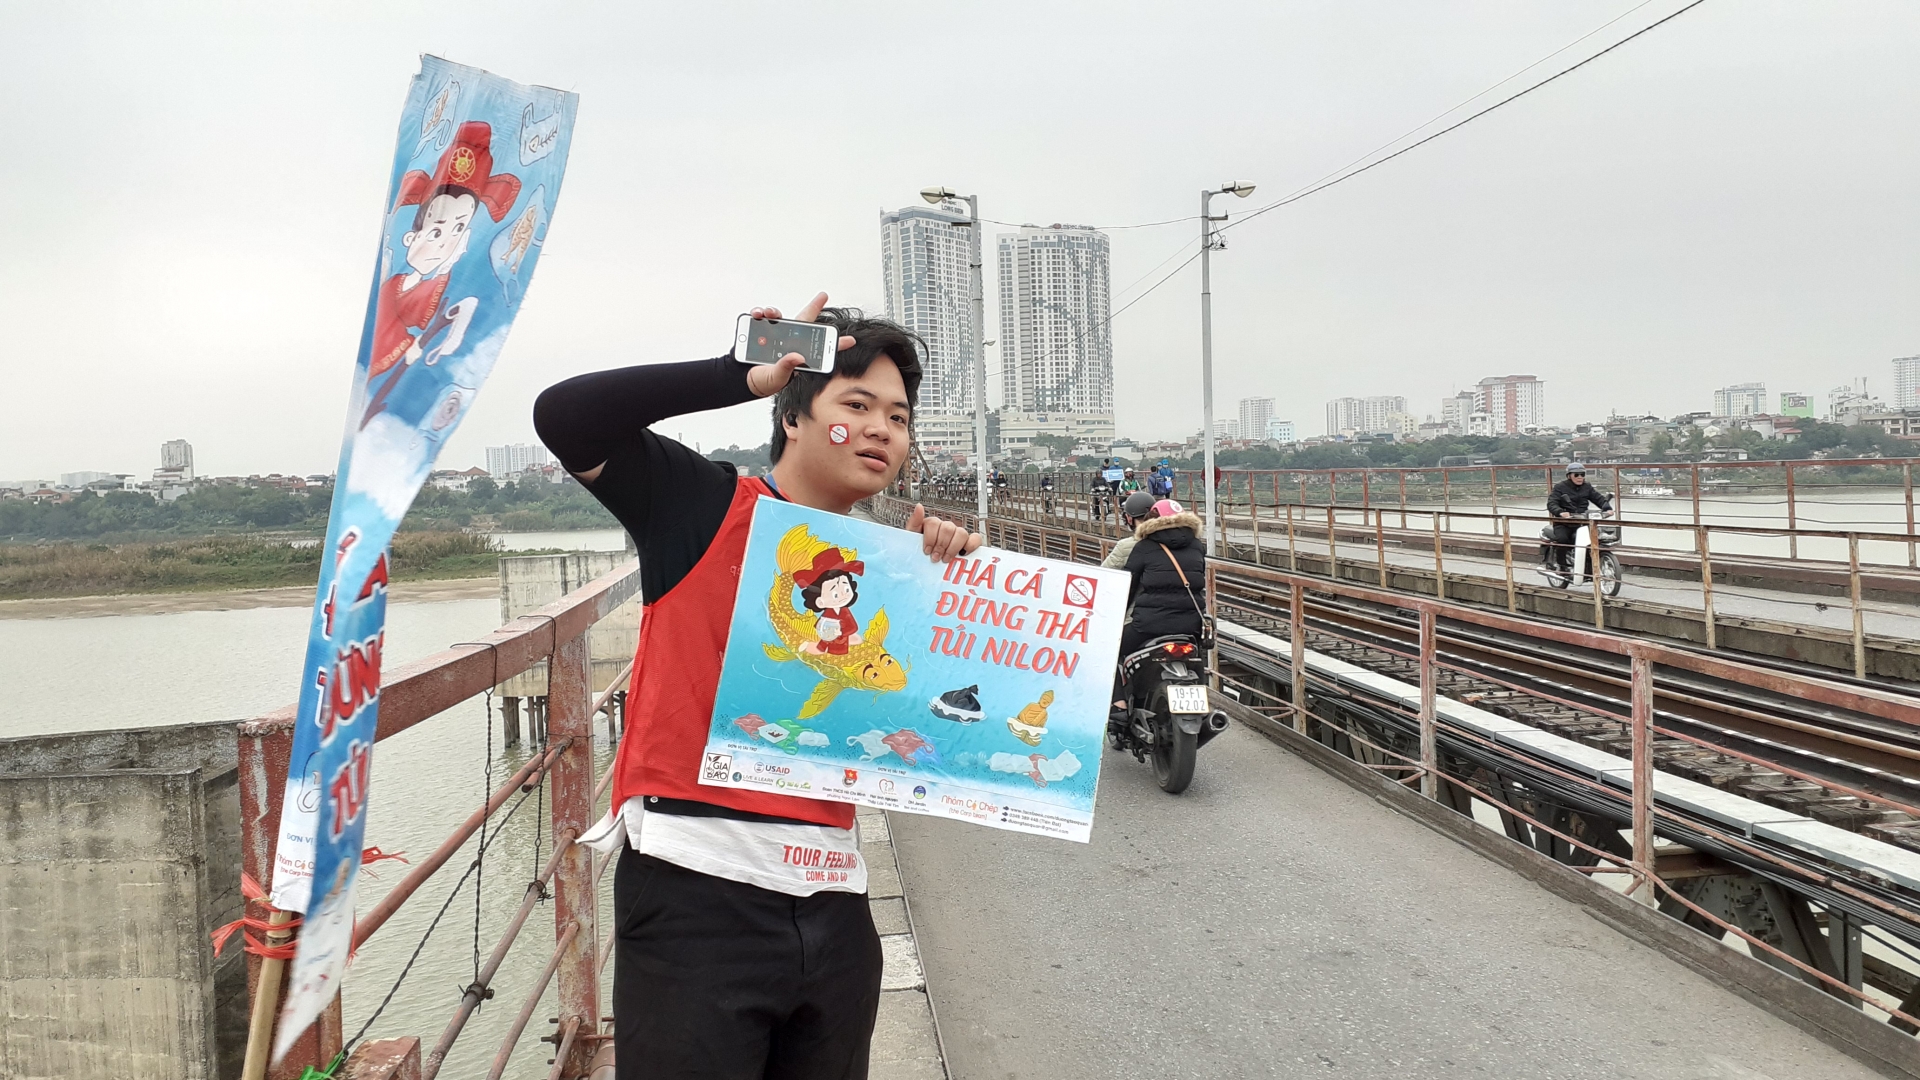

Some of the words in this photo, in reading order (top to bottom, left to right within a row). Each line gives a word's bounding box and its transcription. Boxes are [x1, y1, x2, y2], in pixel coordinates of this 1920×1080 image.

[943, 556, 1001, 590] THẢ
[1004, 567, 1048, 598] CÁ
[934, 589, 1029, 631] ĐỪNG
[1035, 610, 1094, 643] THẢ
[929, 624, 977, 659] TÚI
[981, 636, 1080, 678] NILON
[1175, 688, 1200, 699] 19-F1
[1172, 700, 1206, 711] 242.02
[713, 761, 728, 770] GIA
[765, 764, 790, 775] USAID
[941, 795, 964, 807] Nhóm
[979, 801, 999, 813] Chép
[783, 845, 821, 867] TOUR
[806, 870, 825, 882] COME
[827, 871, 839, 882] AND
